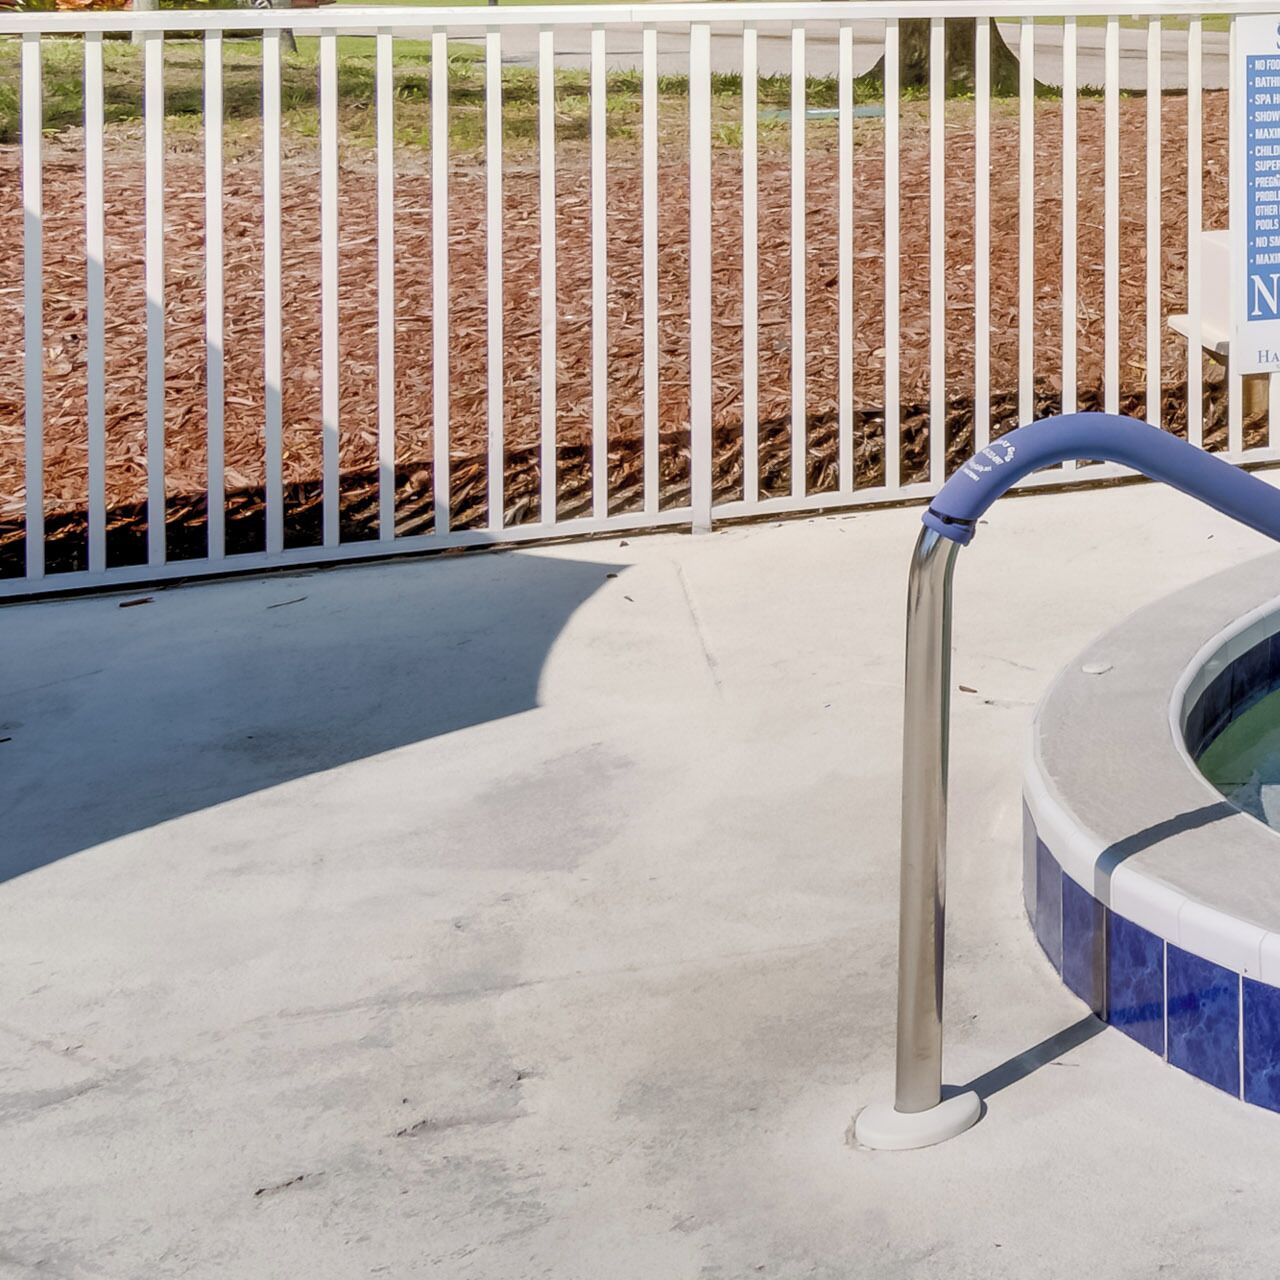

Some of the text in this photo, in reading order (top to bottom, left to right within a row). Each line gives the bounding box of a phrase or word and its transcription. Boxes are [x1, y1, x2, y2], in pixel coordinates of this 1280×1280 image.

[1255, 60, 1265, 70] NO
[1255, 94, 1271, 105] SPA
[1255, 205, 1278, 216] OTHER
[1255, 219, 1279, 230] POOLS
[1256, 236, 1268, 248] NO
